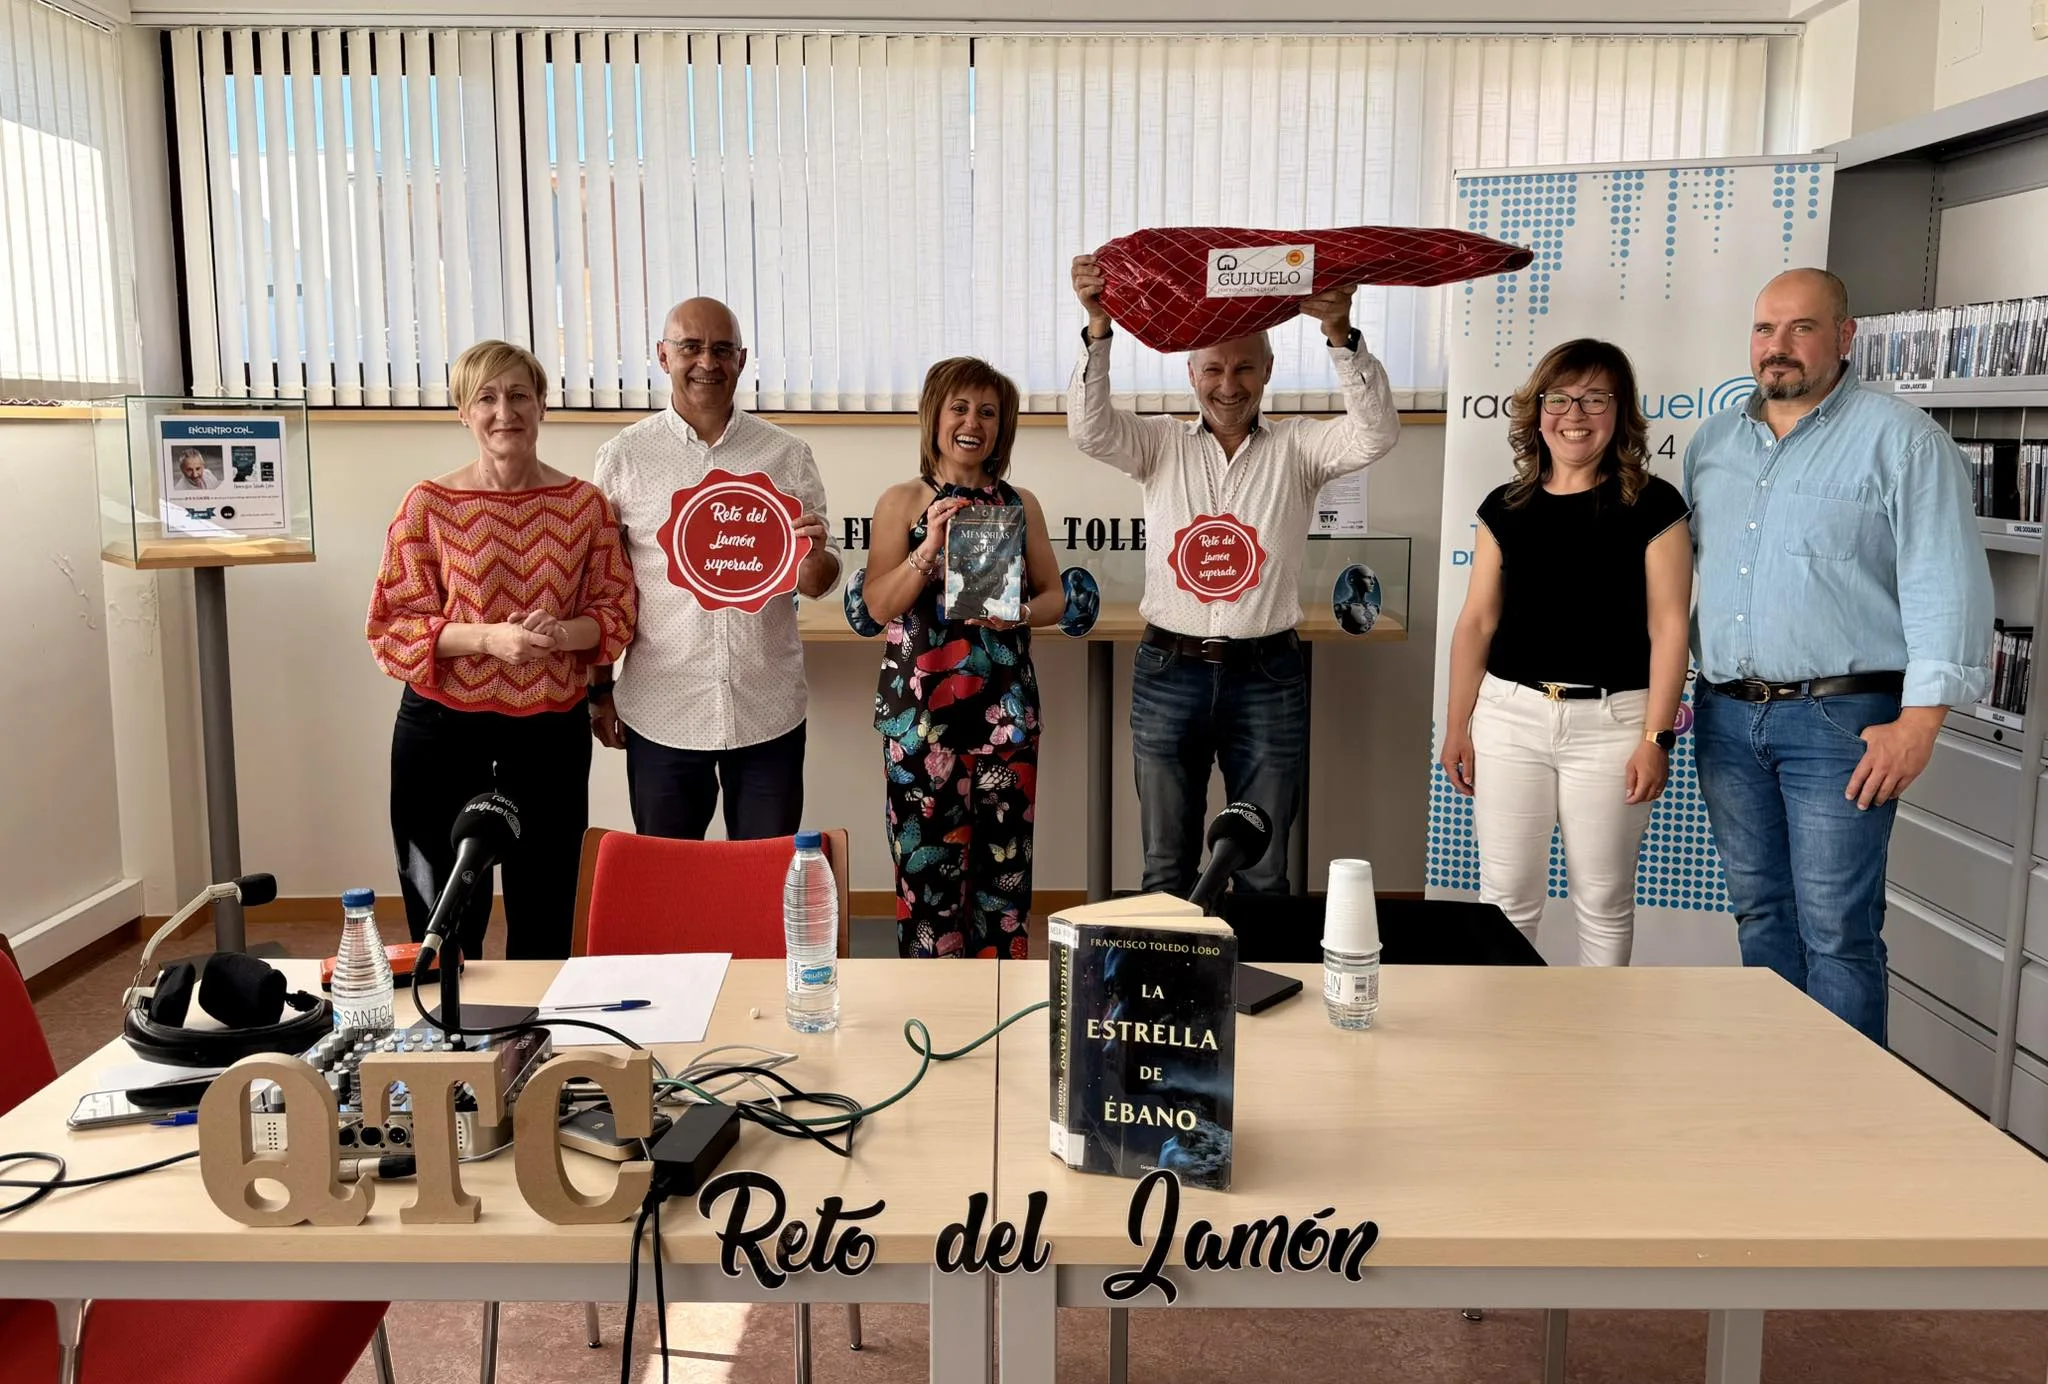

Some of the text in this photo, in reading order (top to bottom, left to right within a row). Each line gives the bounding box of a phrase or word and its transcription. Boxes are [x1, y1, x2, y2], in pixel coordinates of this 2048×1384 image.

[1217, 270, 1301, 286] GUIJUELO
[188, 425, 232, 435] ENCUENTRO
[709, 501, 768, 523] Reto del
[1199, 534, 1236, 548] Reto del
[703, 556, 764, 576] superado
[1198, 565, 1237, 581] superado
[491, 794, 519, 813] radio
[1090, 938, 1221, 957] FRANCISCO TOLEDO LOBO
[1142, 984, 1165, 1000] LA
[1087, 1018, 1219, 1051] ESTRELLA
[1139, 1065, 1163, 1081] DE
[1104, 1095, 1198, 1131] ÉBANO
[697, 1169, 1380, 1307] Reto del Jamón
